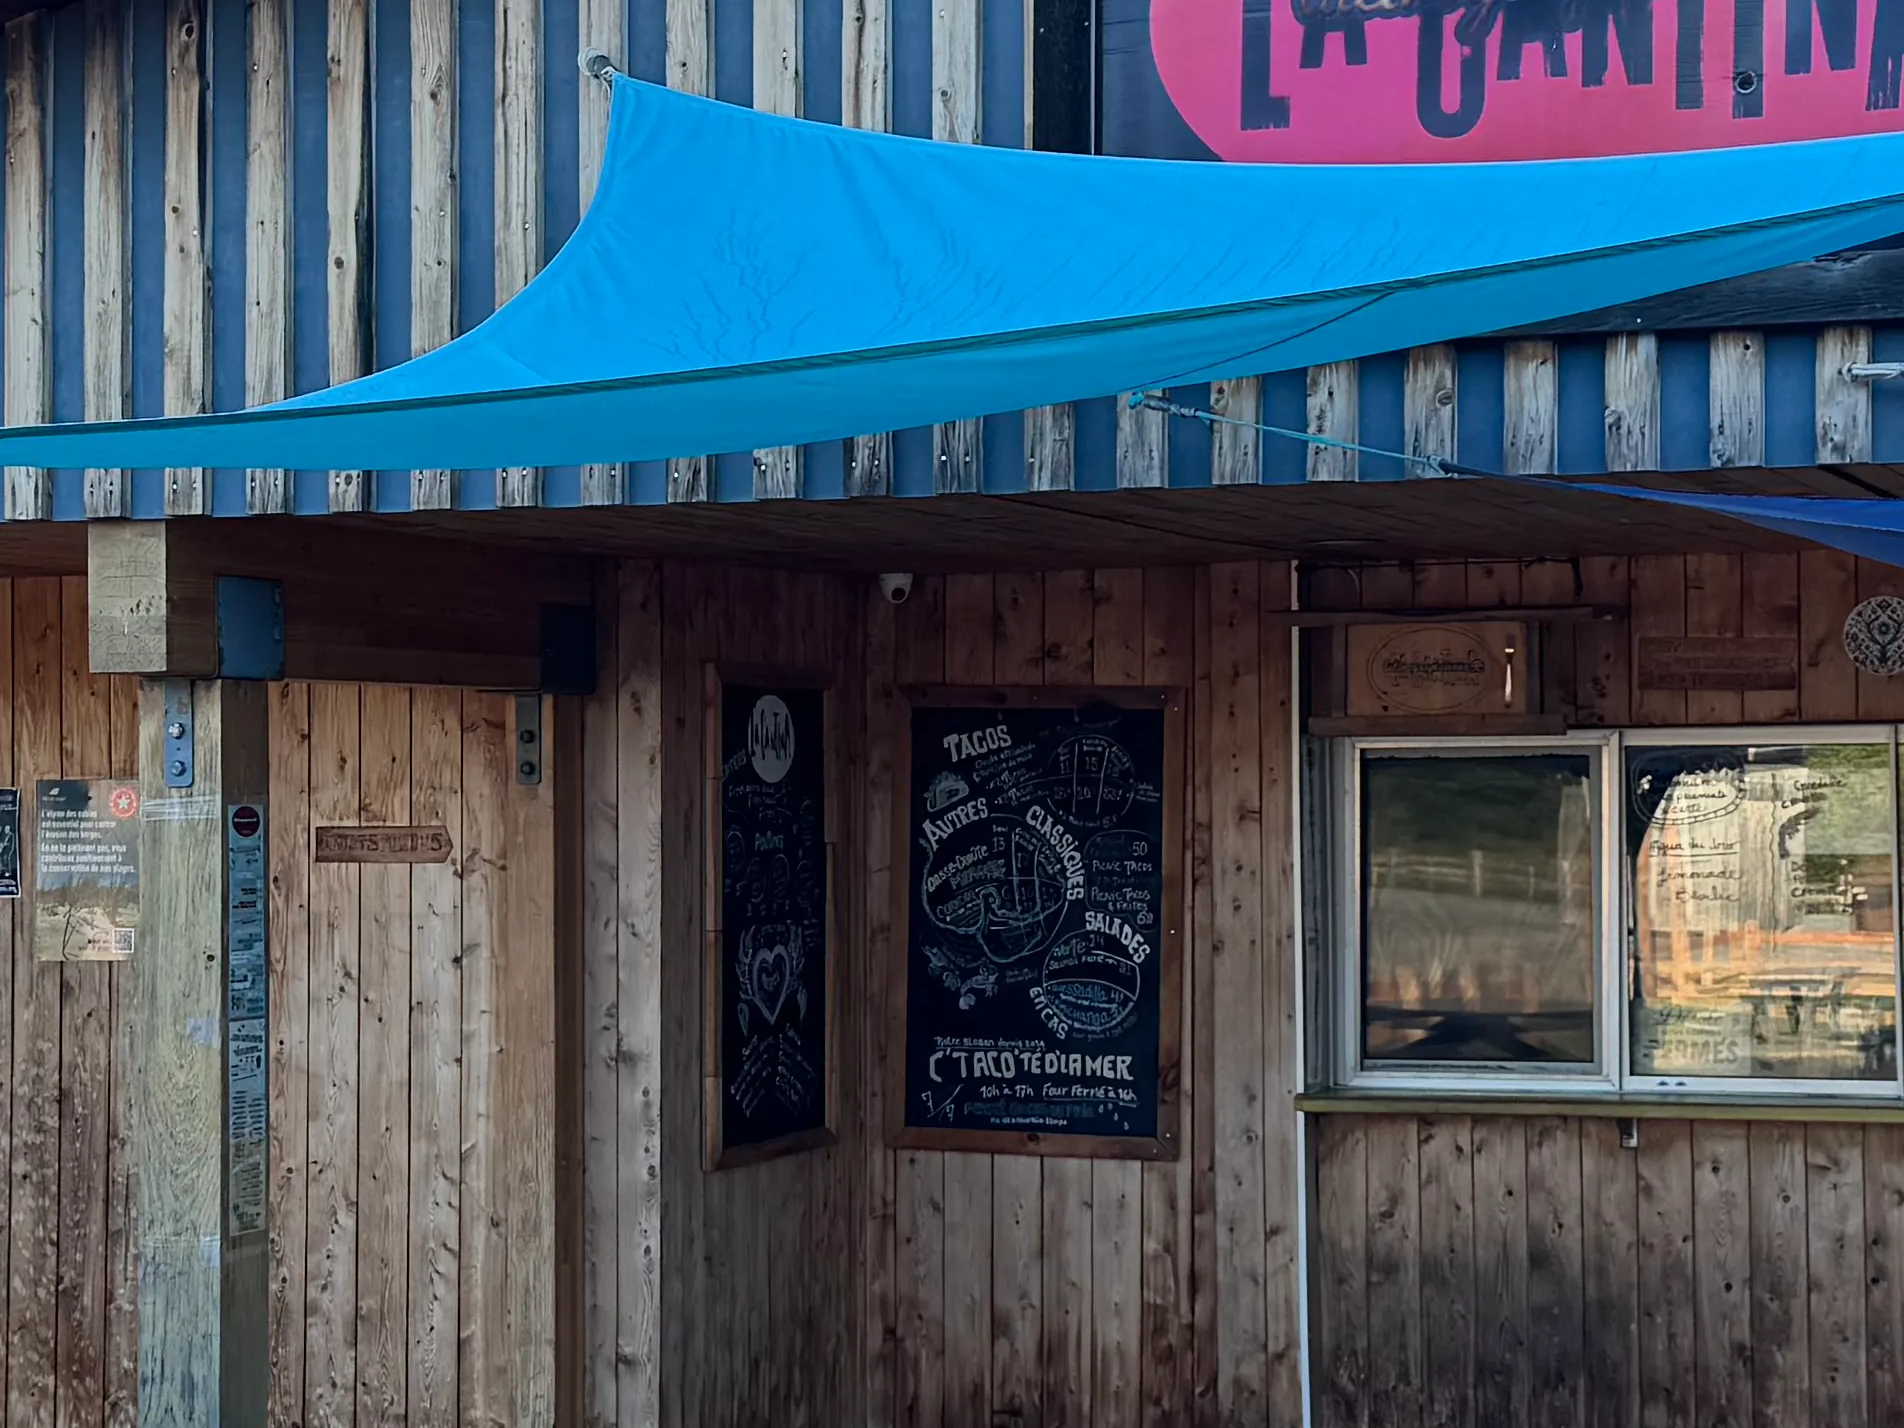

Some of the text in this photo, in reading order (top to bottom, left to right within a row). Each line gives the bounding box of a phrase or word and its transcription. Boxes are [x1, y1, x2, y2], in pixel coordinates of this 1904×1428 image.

[943, 724, 1012, 762] TACOS
[922, 797, 988, 852] AUTRES
[1025, 805, 1086, 901] CLASSIQUES
[1085, 910, 1151, 964] SALADES
[1085, 1054, 1135, 1081] MER
